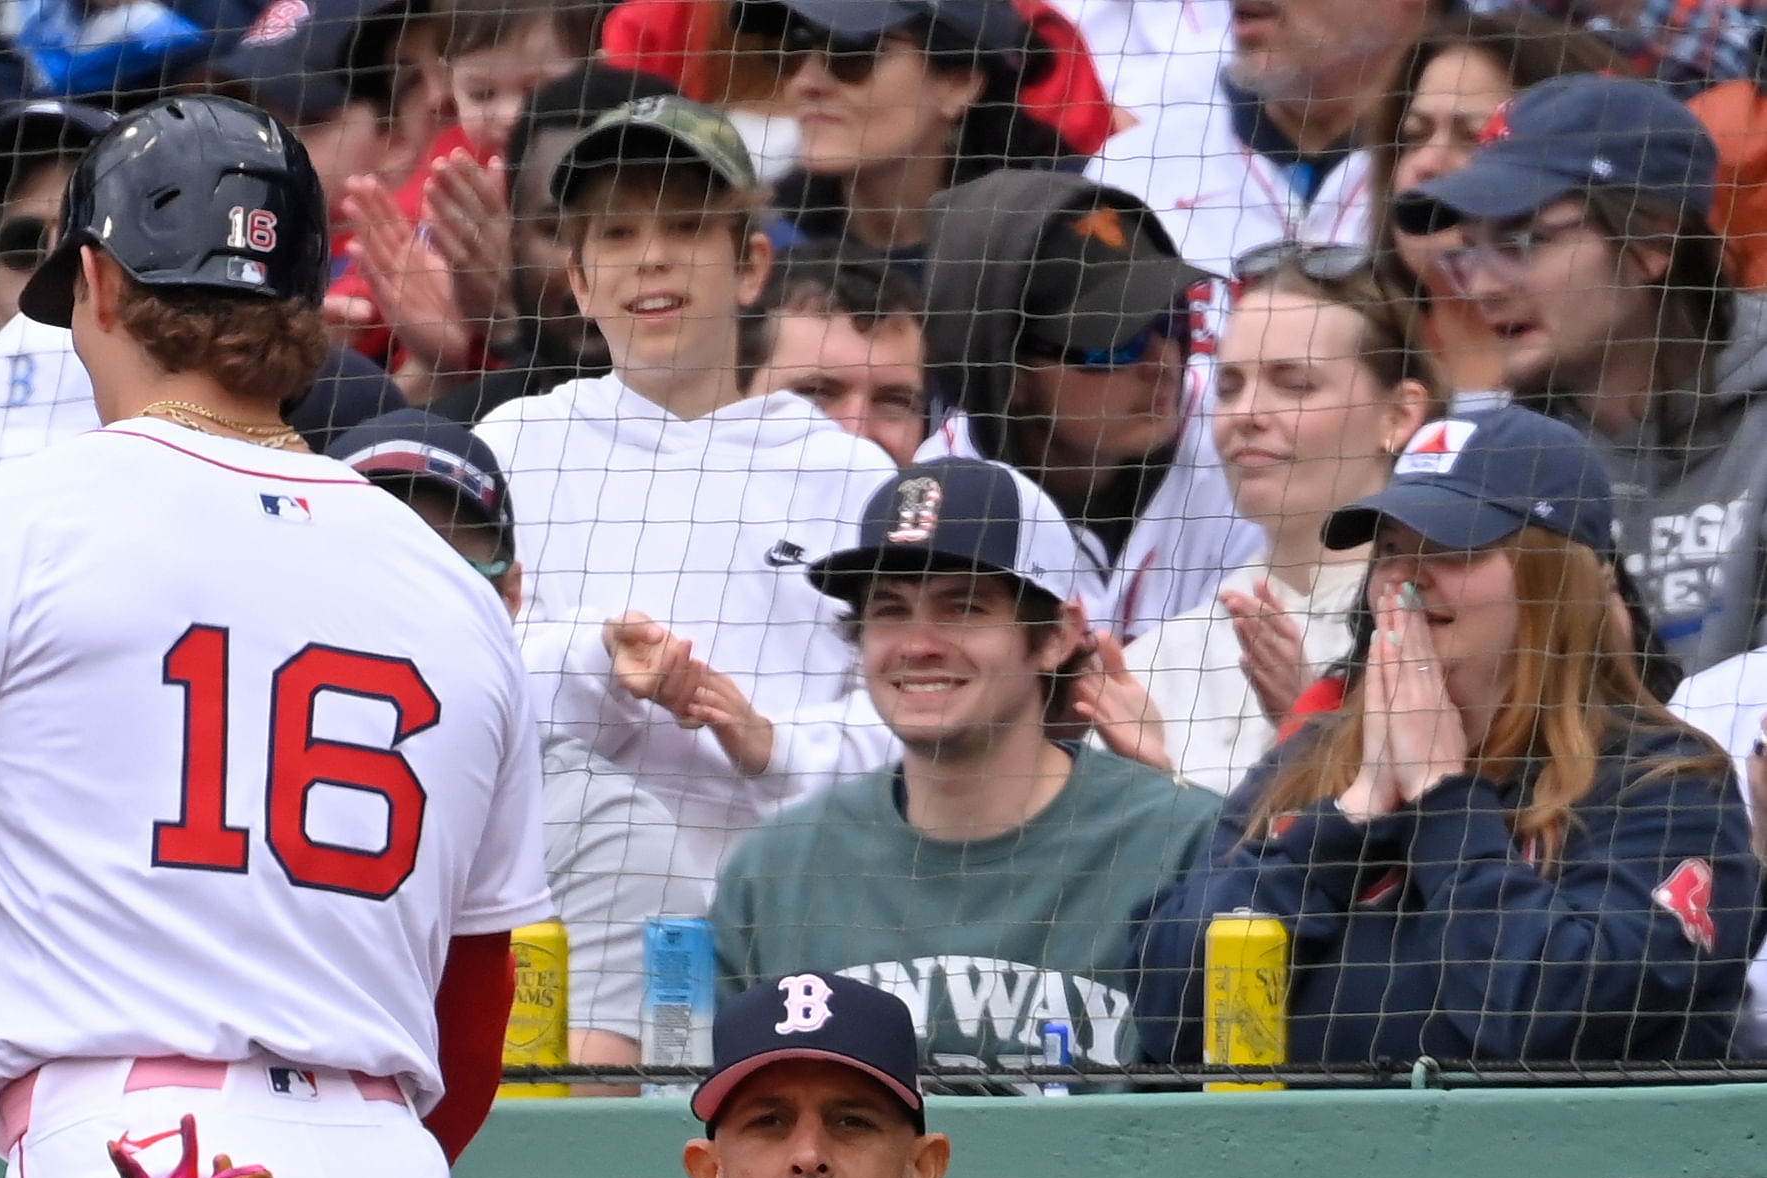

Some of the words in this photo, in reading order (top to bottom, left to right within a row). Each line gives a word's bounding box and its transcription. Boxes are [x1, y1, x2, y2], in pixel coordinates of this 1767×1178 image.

[226, 205, 278, 253] 16
[151, 622, 441, 902] 16
[775, 973, 834, 1034] B
